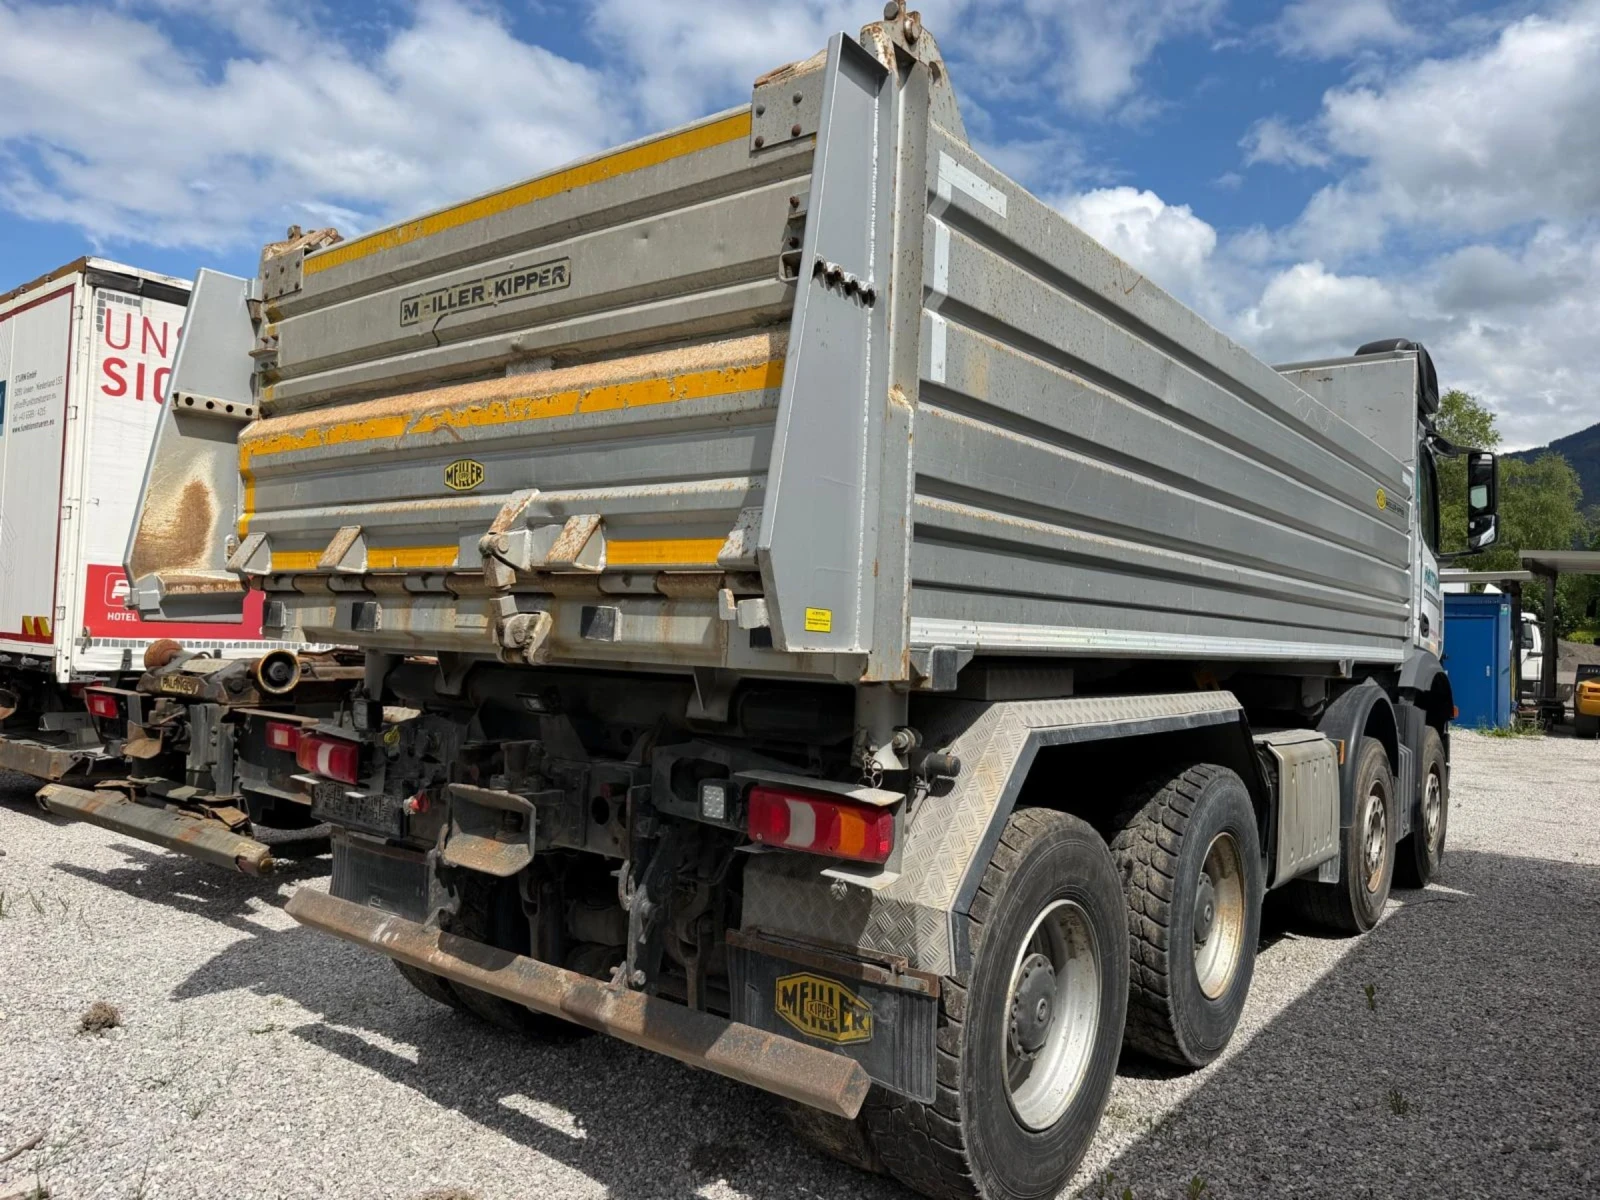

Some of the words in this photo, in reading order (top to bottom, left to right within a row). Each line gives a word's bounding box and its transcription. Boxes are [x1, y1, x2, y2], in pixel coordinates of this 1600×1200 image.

[446, 462, 482, 488] MEILLER
[107, 611, 137, 622] HOTEL
[809, 1003, 835, 1020] KIPPER
